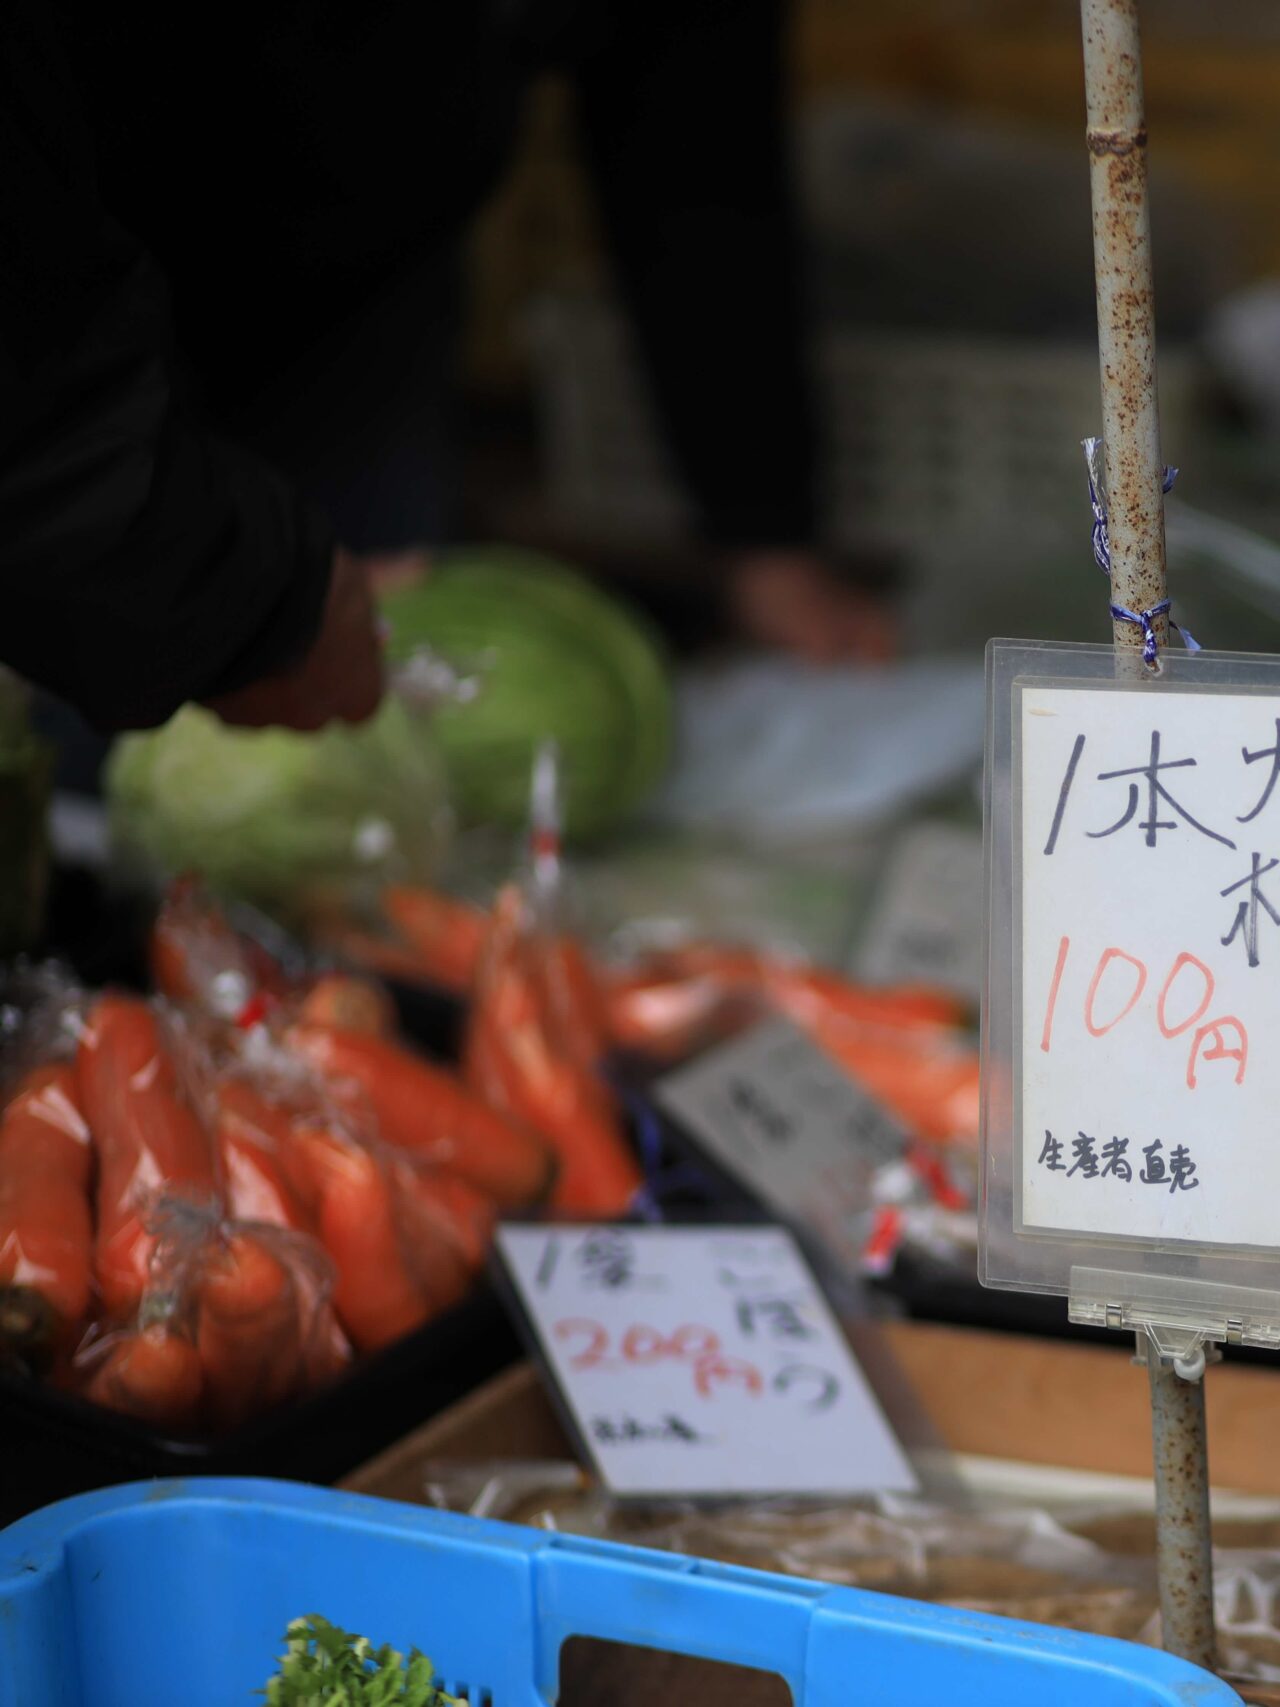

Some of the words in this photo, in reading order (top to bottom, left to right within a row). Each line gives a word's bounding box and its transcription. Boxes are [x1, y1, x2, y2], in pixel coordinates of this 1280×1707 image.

[1043, 730, 1237, 855] 1本
[1041, 935, 1249, 1089] 100円
[1037, 1130, 1200, 1194] 生産者直売
